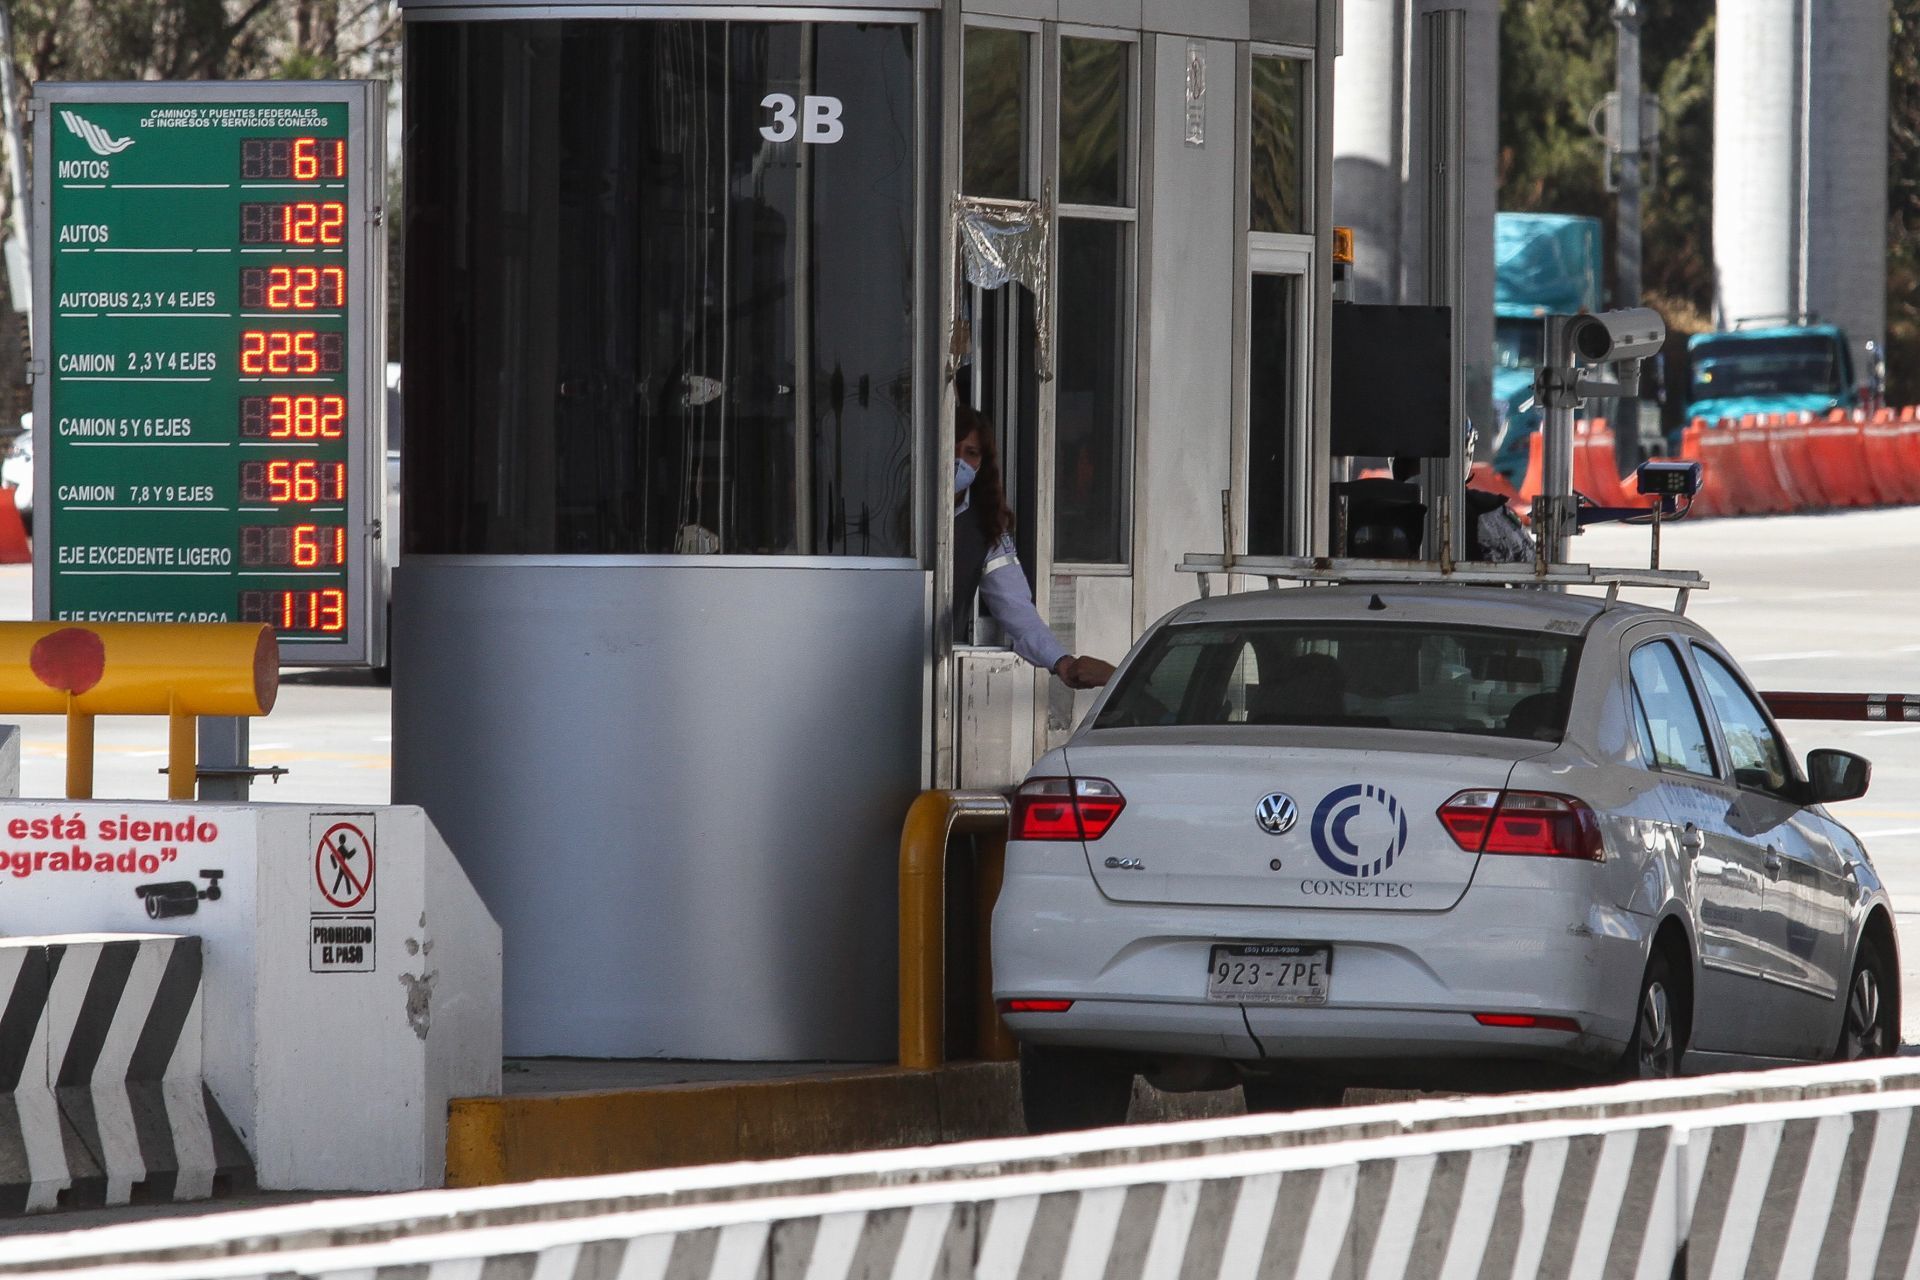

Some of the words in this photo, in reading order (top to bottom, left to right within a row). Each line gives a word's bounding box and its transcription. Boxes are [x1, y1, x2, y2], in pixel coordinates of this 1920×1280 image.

[140, 118, 155, 127] DE
[157, 118, 210, 127] INGRESOS
[212, 118, 219, 127] Y
[221, 118, 276, 127] SERVICIOS
[277, 118, 328, 127] CONEXOS
[150, 109, 198, 118] CAMINOS
[200, 109, 207, 118] Y
[209, 109, 256, 118] PUENTES
[257, 109, 318, 118] FEDERALES
[759, 93, 844, 144] 3B
[293, 138, 344, 179] 61
[58, 160, 110, 179] MOTOS
[283, 203, 344, 243] 122
[59, 224, 109, 243] AUTOS
[268, 268, 344, 308] 227
[59, 292, 128, 308] AUTOBUS
[131, 292, 152, 310] 2,3
[154, 292, 165, 307] Y
[167, 292, 177, 307] 4
[179, 292, 216, 308] EJES
[58, 354, 115, 372] CAMION
[155, 352, 166, 370] Y
[168, 352, 177, 370] 4
[180, 352, 217, 371] EJES
[241, 332, 318, 373] 225
[268, 396, 344, 437] 382
[59, 418, 116, 436] CAMION
[119, 418, 128, 437] 5
[131, 418, 141, 437] Y
[143, 418, 153, 437] 6
[155, 418, 191, 437] EJES
[268, 461, 344, 502] 561
[58, 485, 115, 501] CAMION
[130, 486, 150, 504] 7,8
[153, 486, 163, 501] Y
[166, 486, 175, 501] 9
[178, 486, 214, 501] EJES
[58, 546, 85, 564] EJE
[89, 546, 174, 565] EXCEDENTE
[178, 547, 232, 565] LIGERO
[293, 524, 344, 567] 61
[283, 590, 344, 630] 113
[7, 812, 86, 840] está
[98, 814, 218, 843] siendo
[1300, 879, 1413, 898] CONSETEC
[313, 926, 373, 944] PROHIBIDO
[322, 945, 335, 964] EL
[335, 945, 364, 964] PASO
[1217, 962, 1321, 987] 923-ZPE
